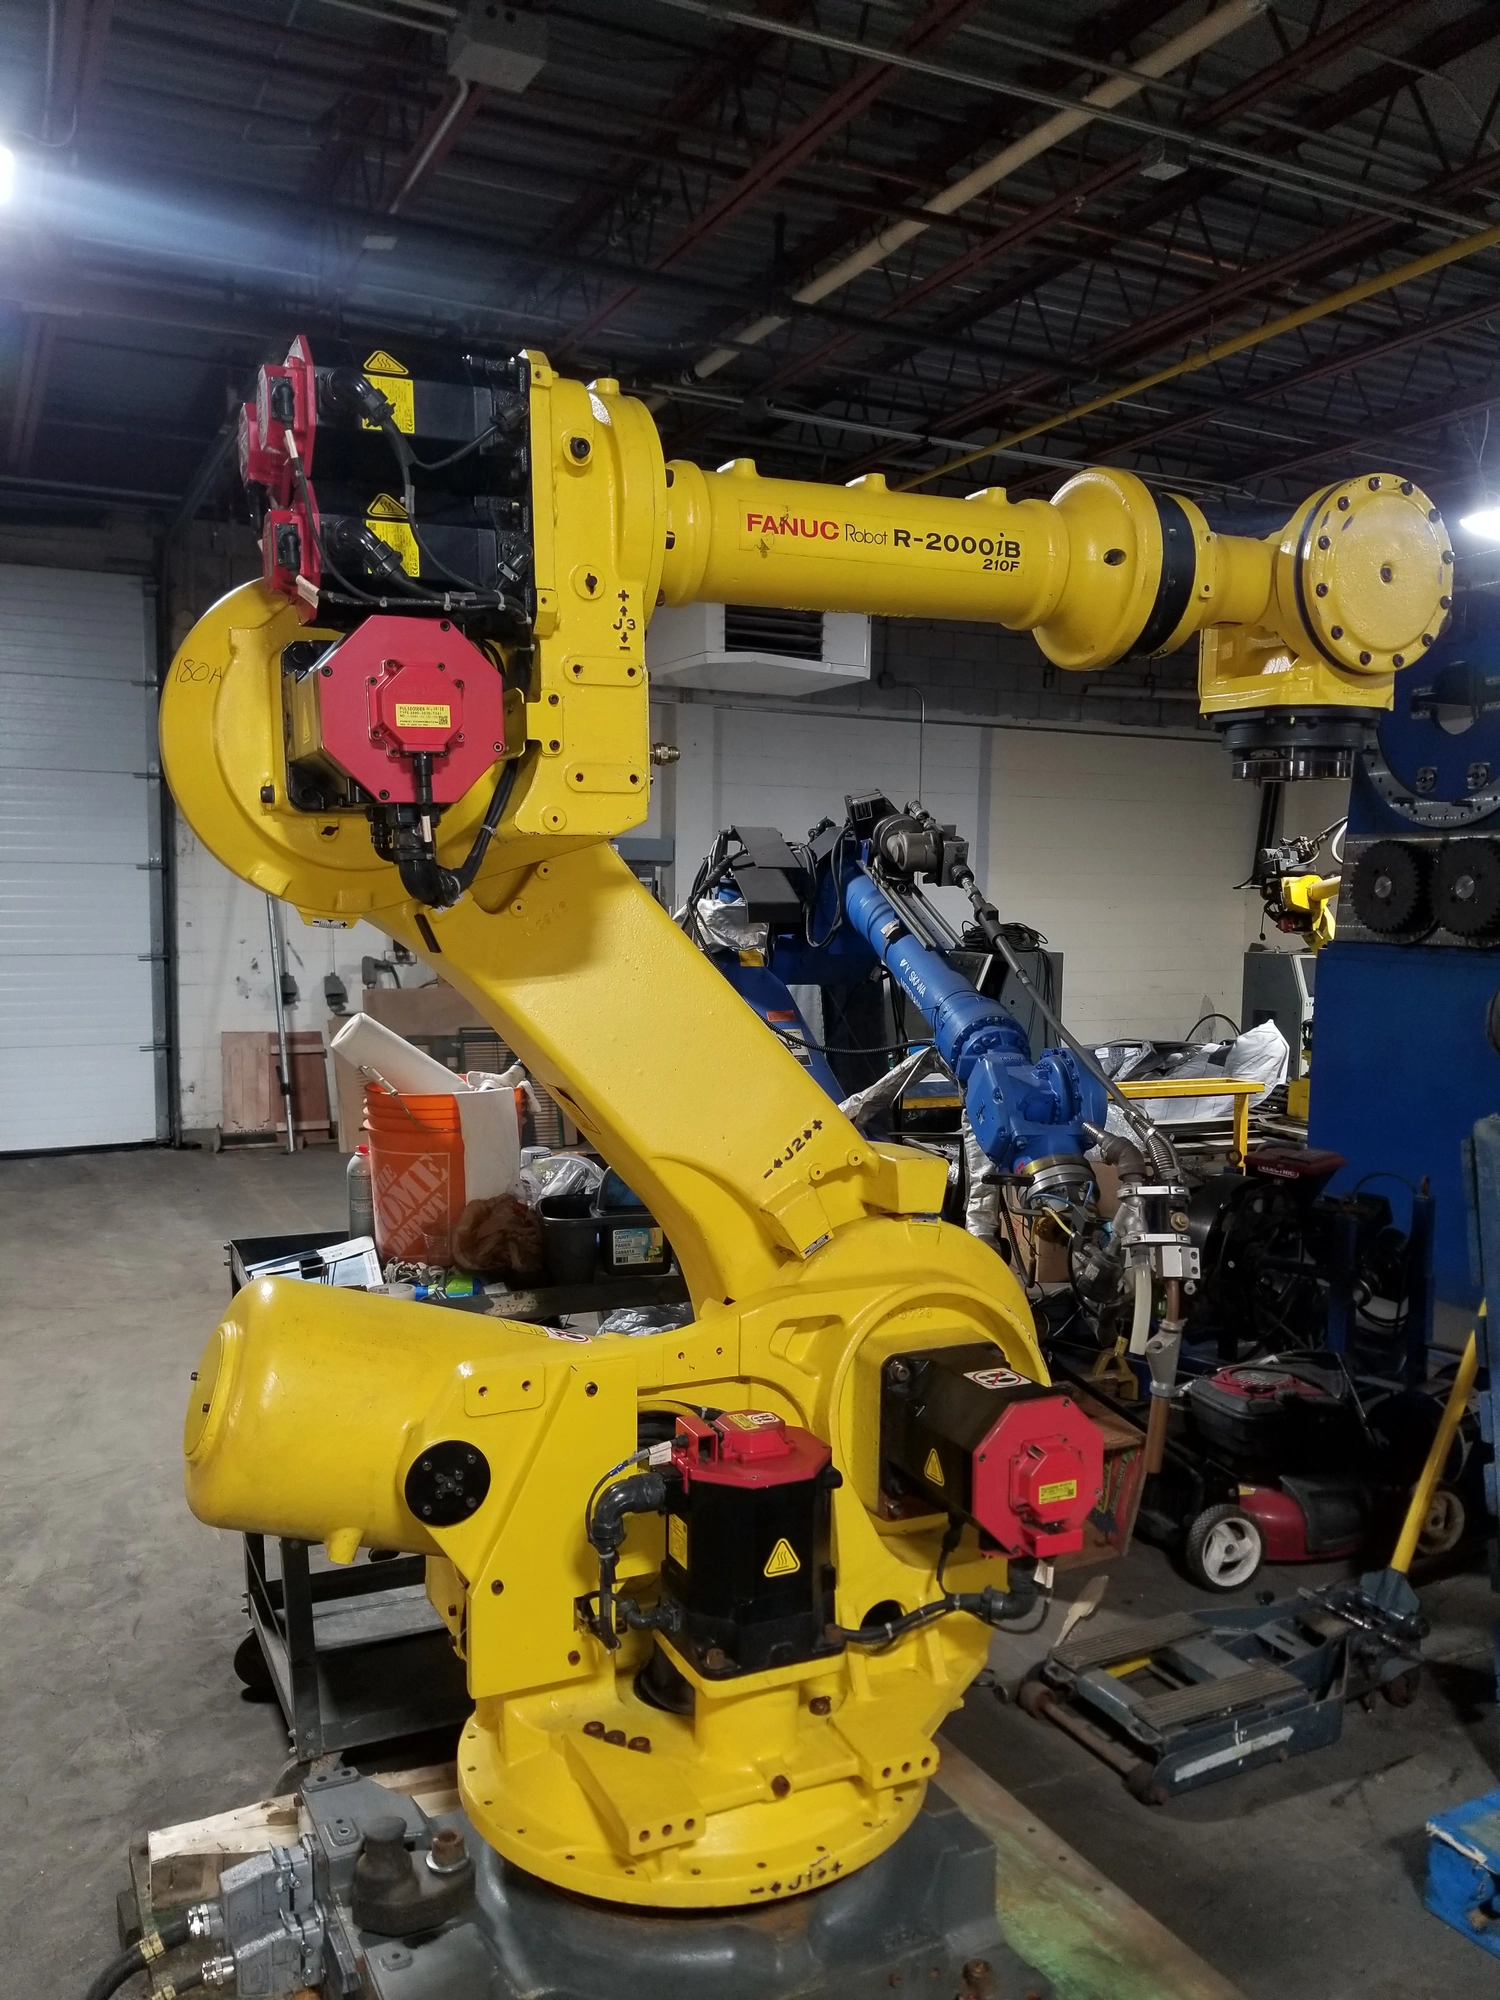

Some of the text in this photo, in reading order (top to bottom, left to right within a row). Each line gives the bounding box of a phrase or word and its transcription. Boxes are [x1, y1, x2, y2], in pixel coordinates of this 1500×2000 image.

[747, 513, 1021, 559] FANUC Robot R-2000iB
[982, 558, 1020, 573] 210F
[612, 618, 636, 631] J3
[784, 1137, 806, 1161] J2
[788, 1869, 812, 1891] J1
